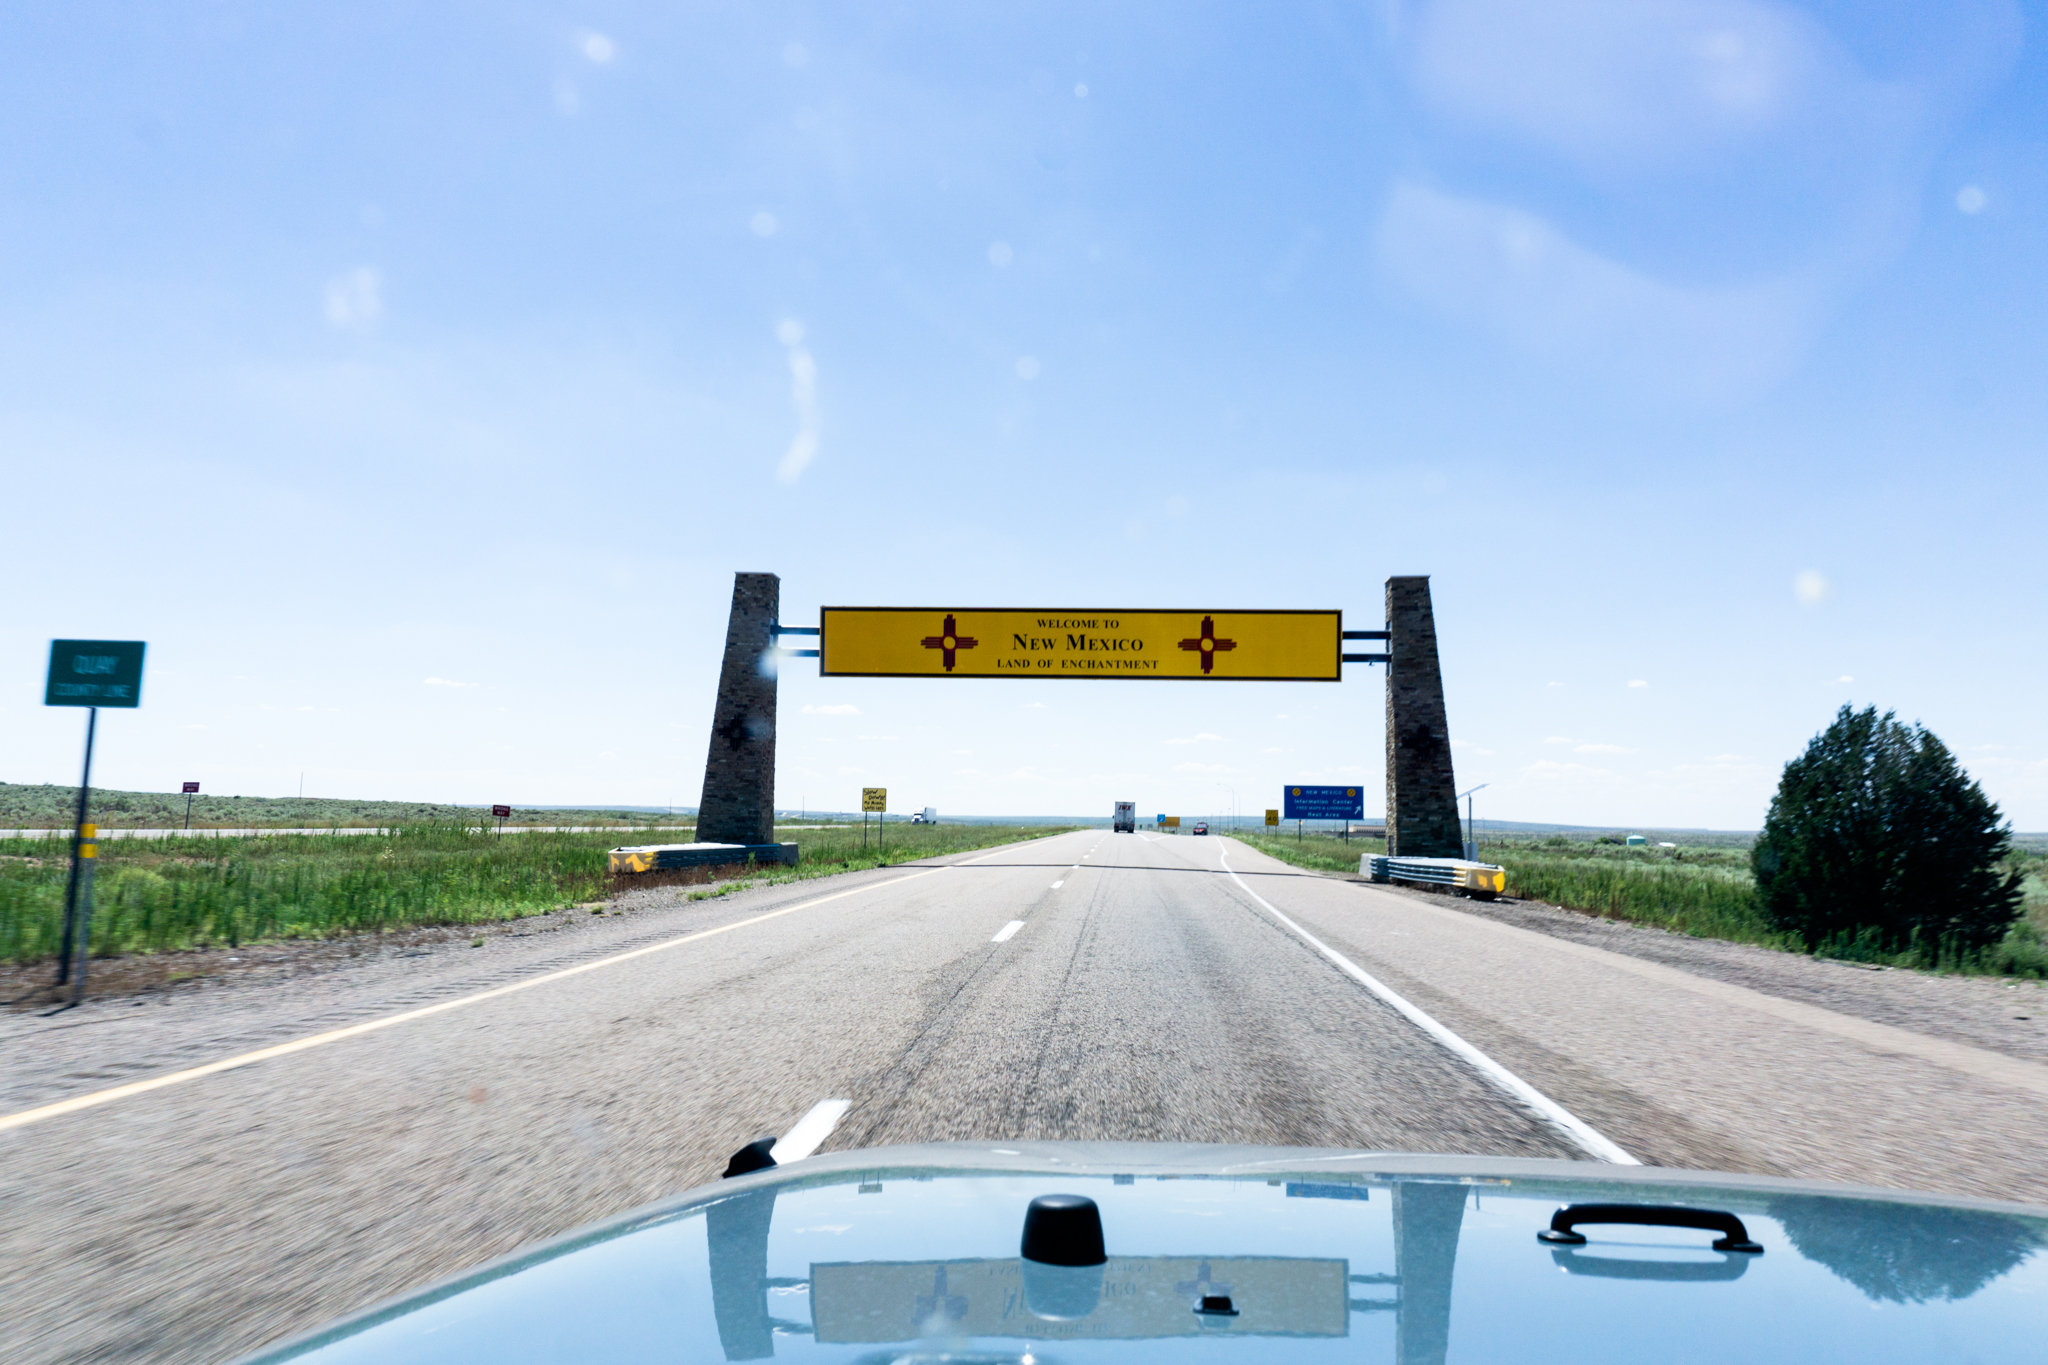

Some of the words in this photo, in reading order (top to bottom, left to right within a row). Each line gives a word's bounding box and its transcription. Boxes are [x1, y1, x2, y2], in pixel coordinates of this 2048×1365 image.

[1037, 618, 1099, 629] WELCOME
[1102, 619, 1120, 629] TO
[1012, 633, 1057, 651] NEW
[1066, 633, 1144, 652] MEXICO
[997, 658, 1031, 668] LAND
[1037, 658, 1054, 669] OF
[1061, 659, 1159, 670] ENCHANTMENT
